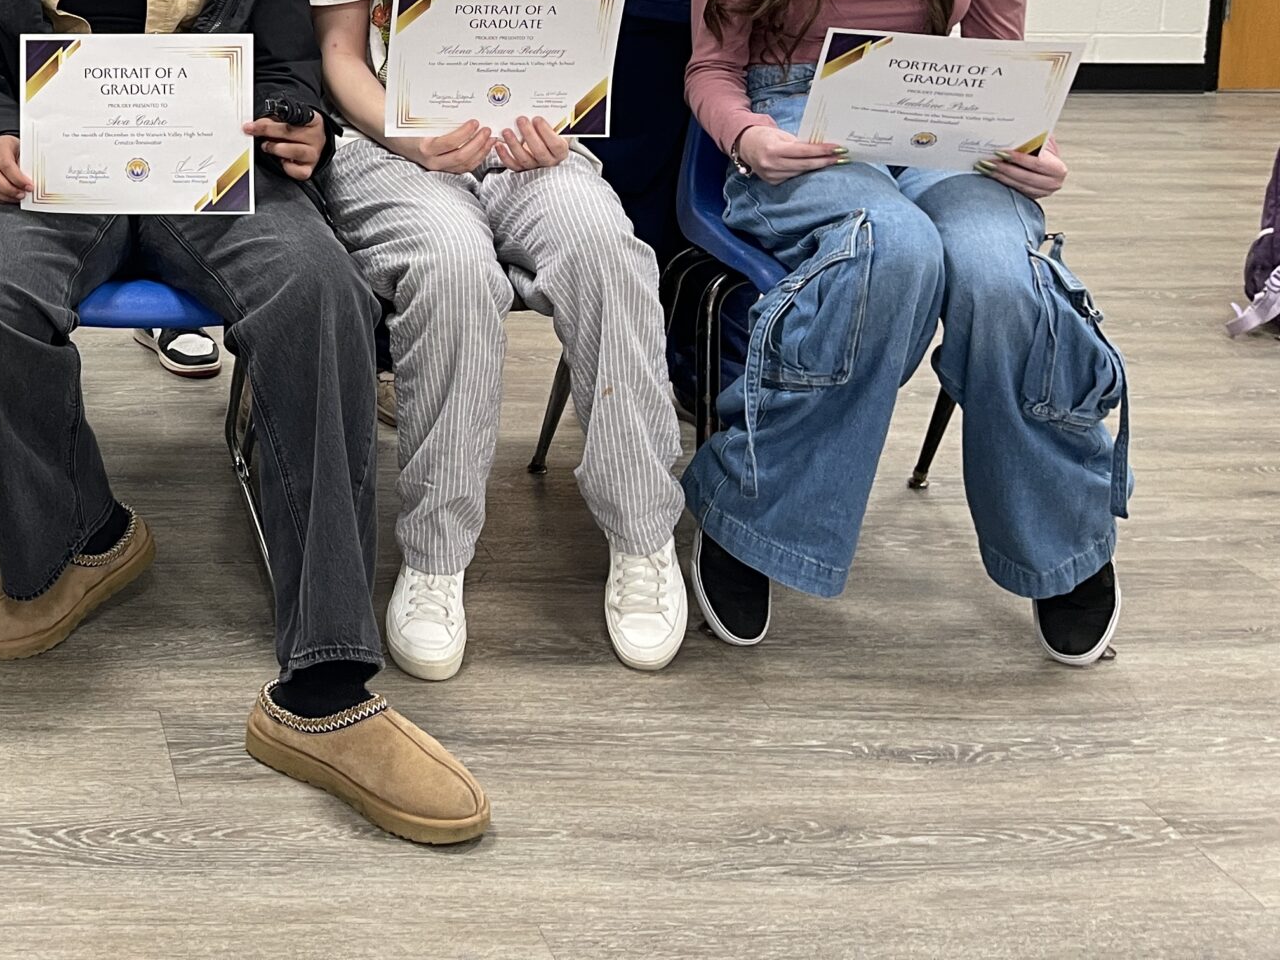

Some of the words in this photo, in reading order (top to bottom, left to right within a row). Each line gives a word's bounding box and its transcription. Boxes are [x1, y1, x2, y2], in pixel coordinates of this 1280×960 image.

[455, 5, 522, 15] PORTRAIT
[525, 5, 543, 15] OF
[546, 5, 557, 15] A
[469, 19, 543, 29] GRADUATE
[438, 44, 472, 55] Helena
[84, 67, 150, 79] PORTRAIT
[155, 67, 173, 79] OF
[177, 67, 188, 79] A
[889, 59, 964, 74] PORTRAIT
[967, 66, 989, 75] OF
[992, 67, 1003, 76] A
[902, 73, 986, 88] GRADUATE
[100, 84, 175, 95] GRADUATE
[106, 115, 130, 126] Ava
[135, 114, 168, 126] Castro
